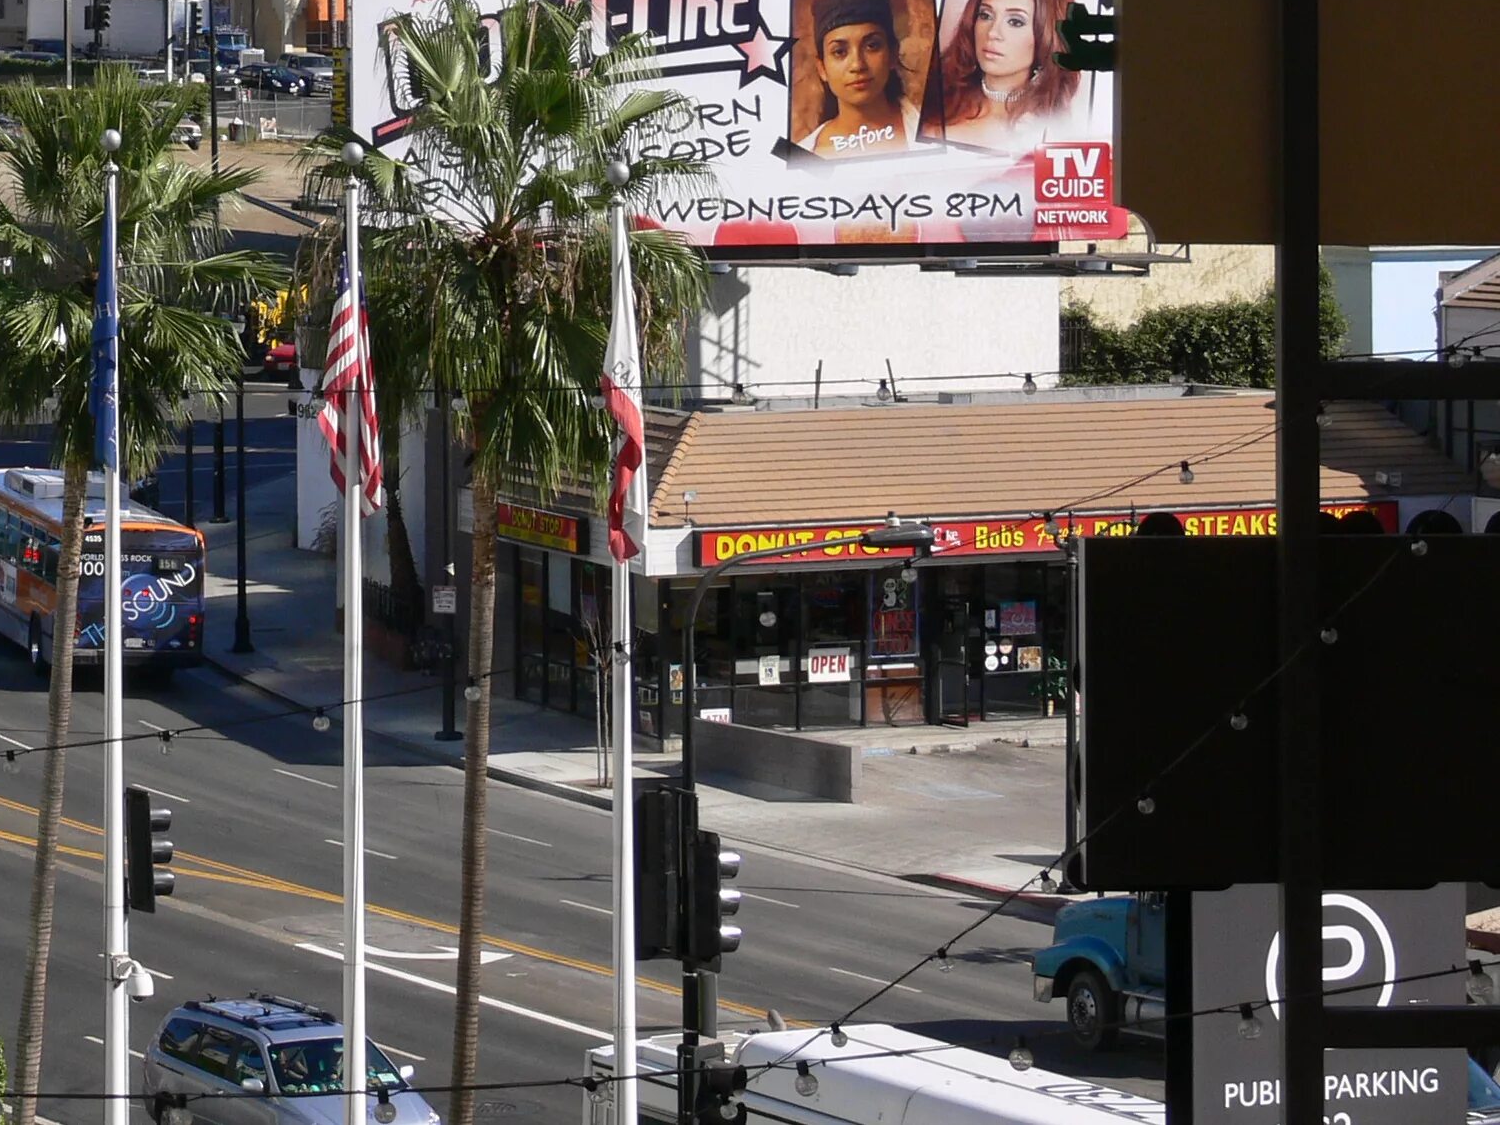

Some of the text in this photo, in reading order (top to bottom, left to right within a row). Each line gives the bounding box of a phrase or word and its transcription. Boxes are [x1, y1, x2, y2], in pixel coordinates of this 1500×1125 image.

[830, 124, 895, 153] Before
[1046, 148, 1100, 177] TV
[1041, 179, 1105, 198] GUIDE
[656, 192, 1023, 231] WEDNESDAYS 8PM
[1037, 208, 1108, 225] NETWORK
[715, 531, 814, 562] DONUT
[933, 528, 960, 543] Cke
[974, 525, 1025, 549] Bob's
[122, 563, 196, 621] SOUND
[811, 654, 847, 674] OPEN
[1324, 1068, 1439, 1100] PARKING
